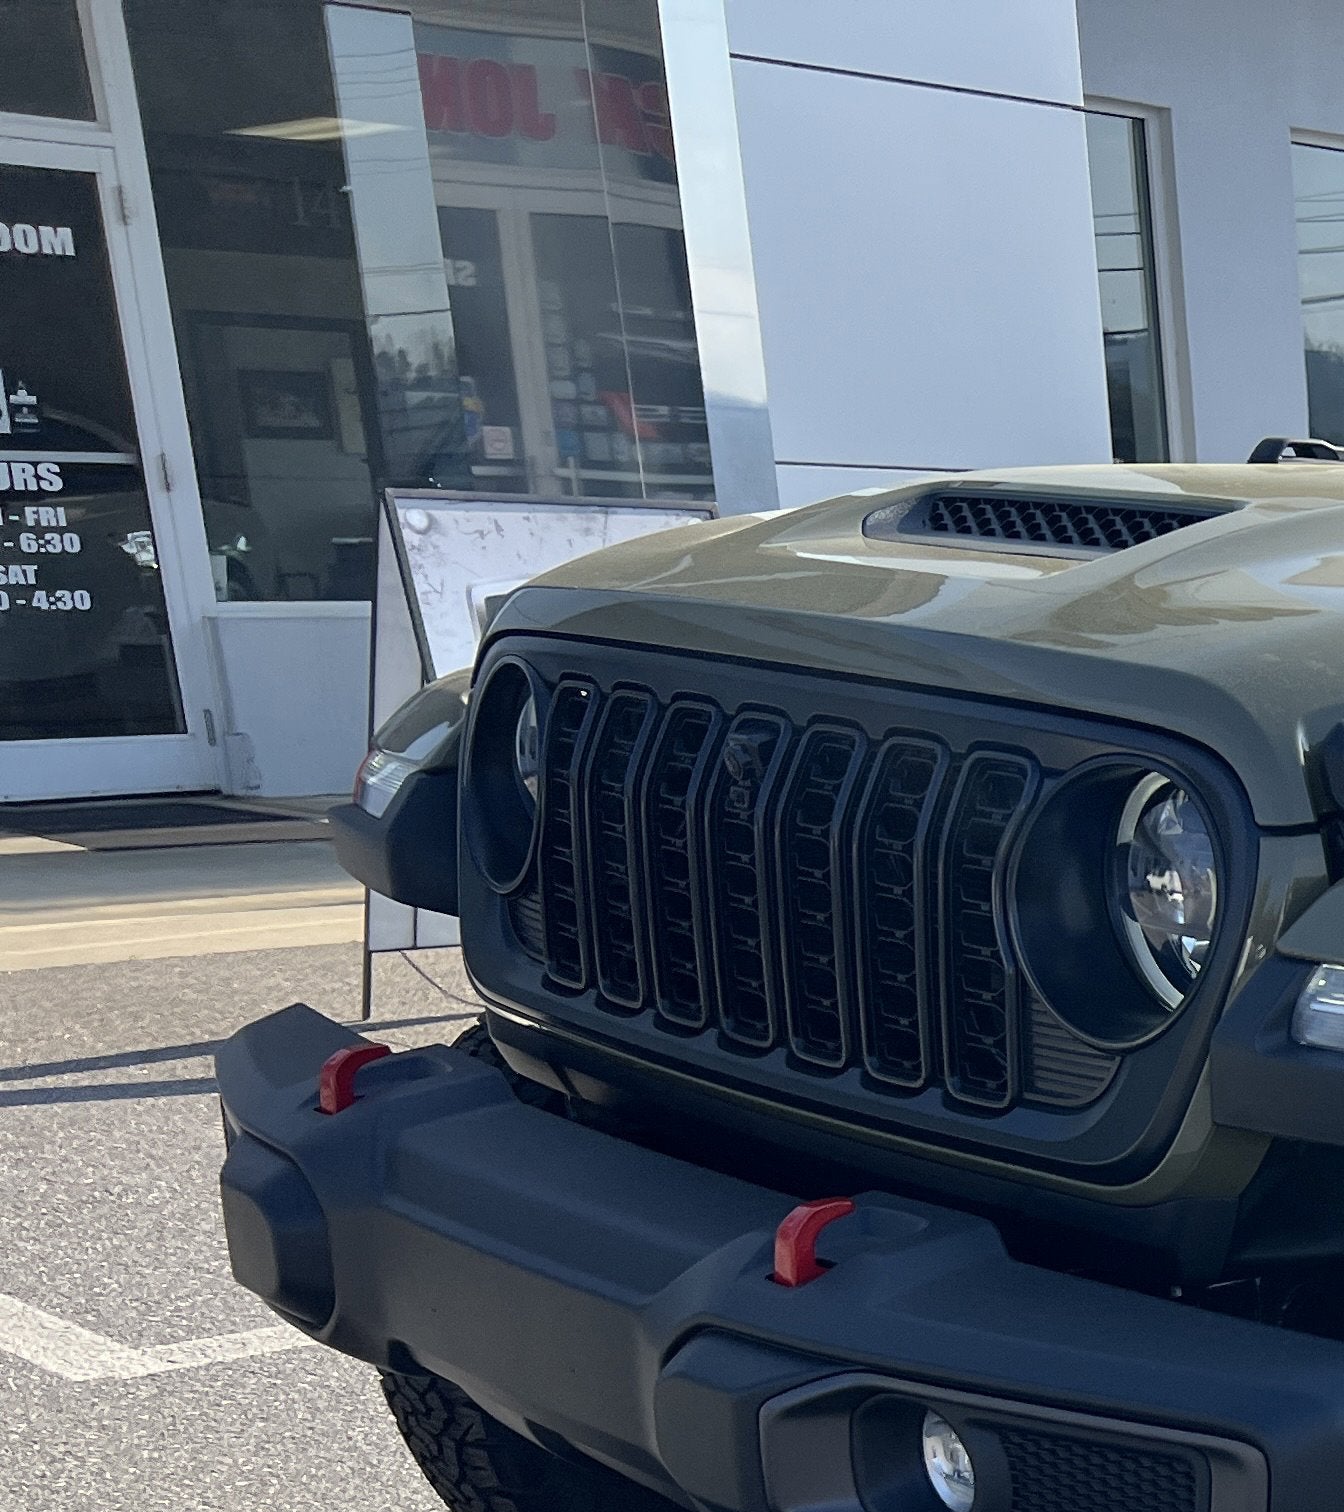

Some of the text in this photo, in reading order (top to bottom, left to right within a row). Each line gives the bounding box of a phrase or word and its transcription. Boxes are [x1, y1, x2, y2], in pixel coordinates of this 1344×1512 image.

[24, 506, 68, 527] FRI
[19, 532, 82, 554] 6:30
[32, 589, 92, 612] 4:30
